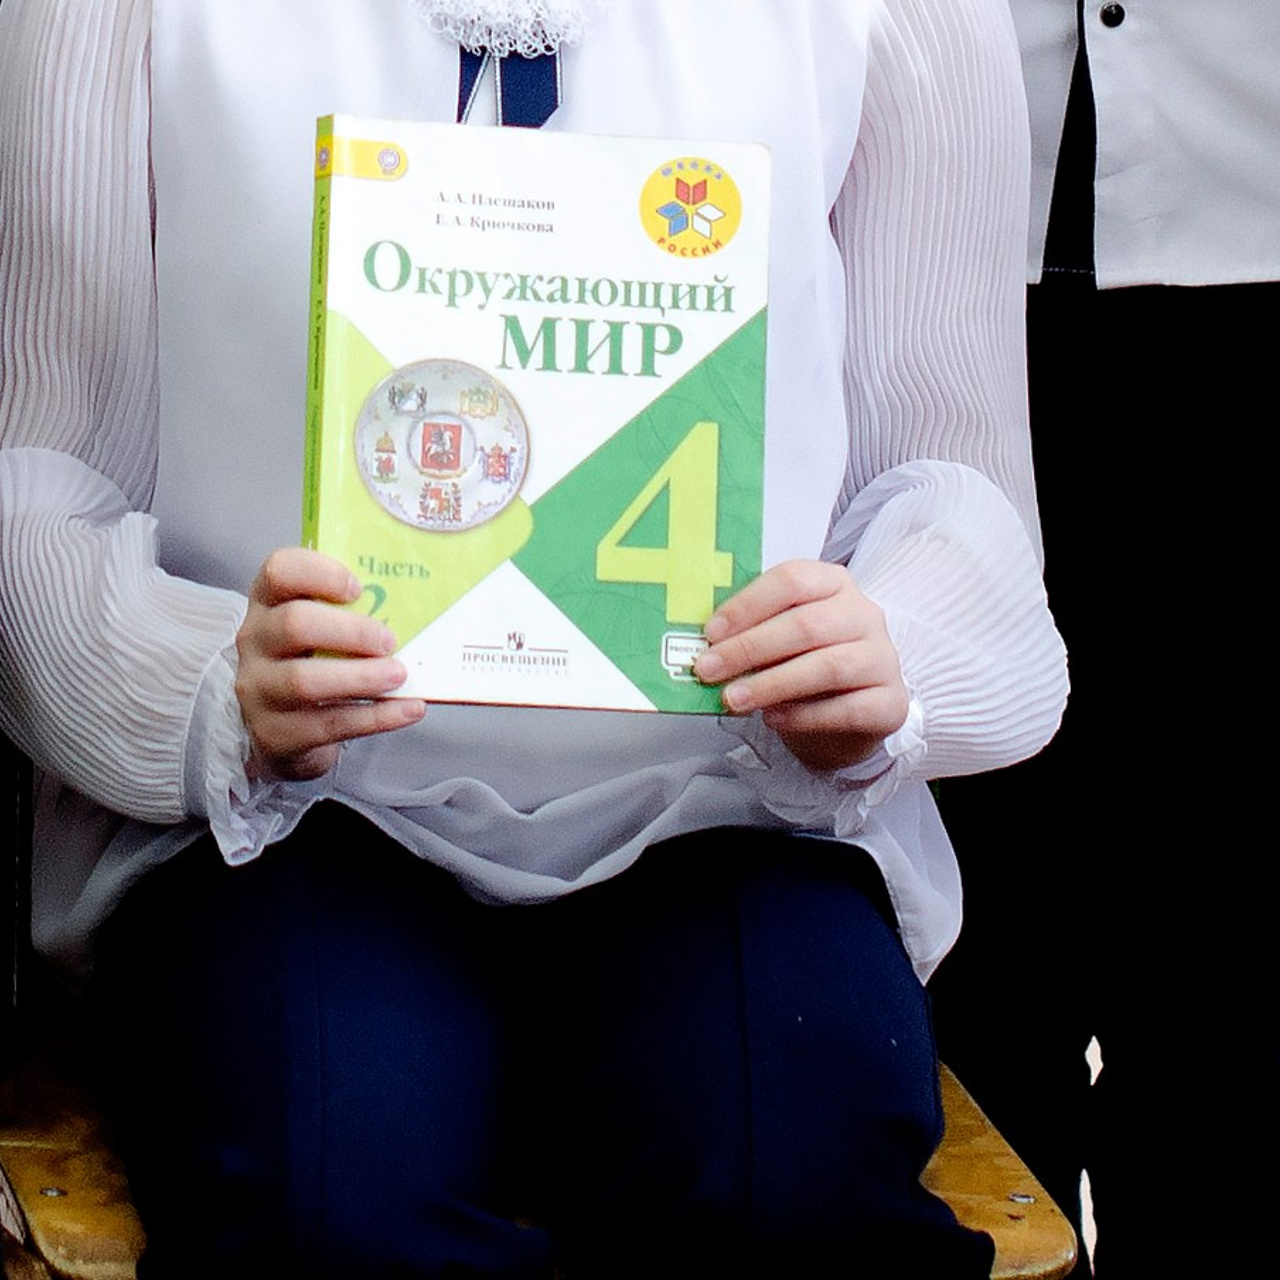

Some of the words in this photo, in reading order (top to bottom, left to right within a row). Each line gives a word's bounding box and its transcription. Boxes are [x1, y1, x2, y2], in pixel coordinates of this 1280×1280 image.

[471, 192, 556, 211] Плешаков
[470, 215, 555, 233] Крючкова
[656, 236, 723, 257] РОССИИ
[363, 239, 736, 316] Окружающий
[497, 313, 685, 380] МИР
[595, 420, 734, 624] 4
[358, 555, 431, 580] Часть
[462, 651, 568, 668] ПРОСВЕЩЕНИЕ
